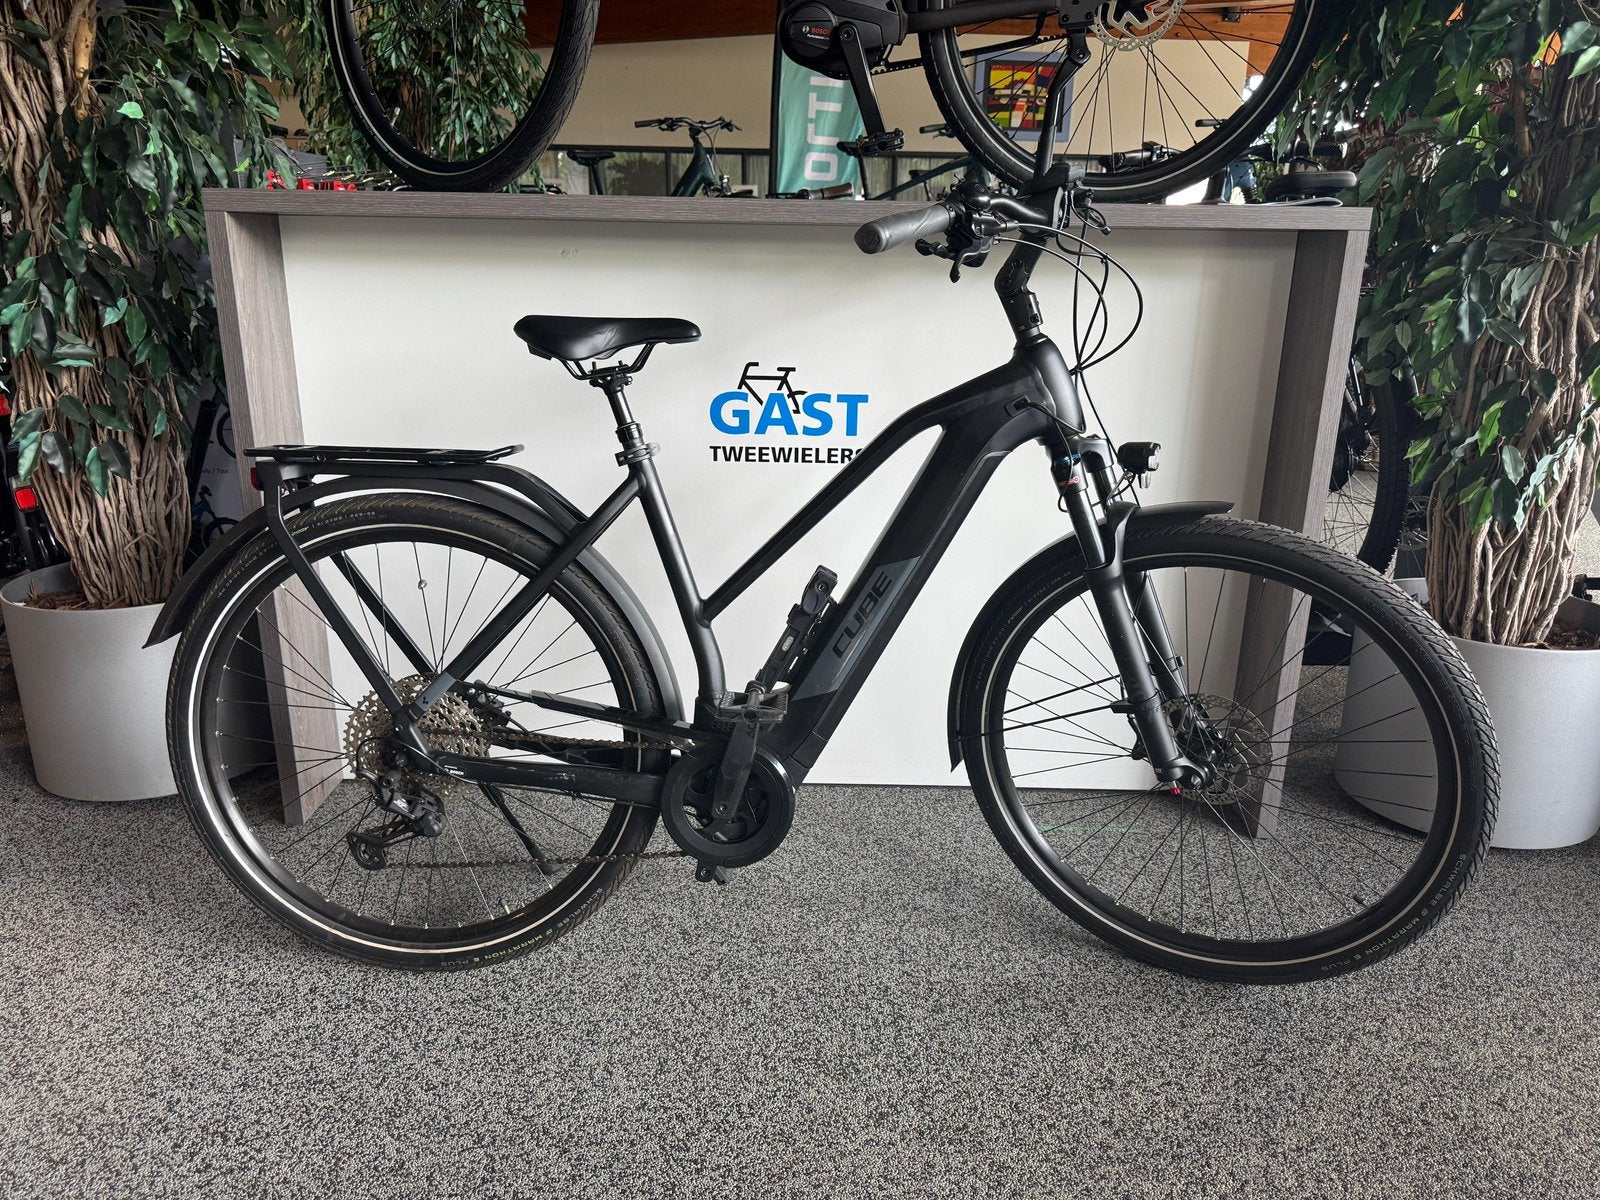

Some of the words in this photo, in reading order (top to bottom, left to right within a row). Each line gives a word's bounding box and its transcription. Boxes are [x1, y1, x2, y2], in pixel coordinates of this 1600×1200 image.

[811, 27, 831, 35] BOSCH
[709, 391, 869, 436] GAST
[832, 570, 892, 658] CUBE
[1429, 853, 1467, 907] SCHWALBE
[555, 887, 603, 928] SCHWALBE
[484, 934, 543, 961] MARATHON
[1364, 916, 1421, 956] MARATHON
[440, 958, 470, 967] PLUS
[1320, 959, 1352, 972] PLUS
